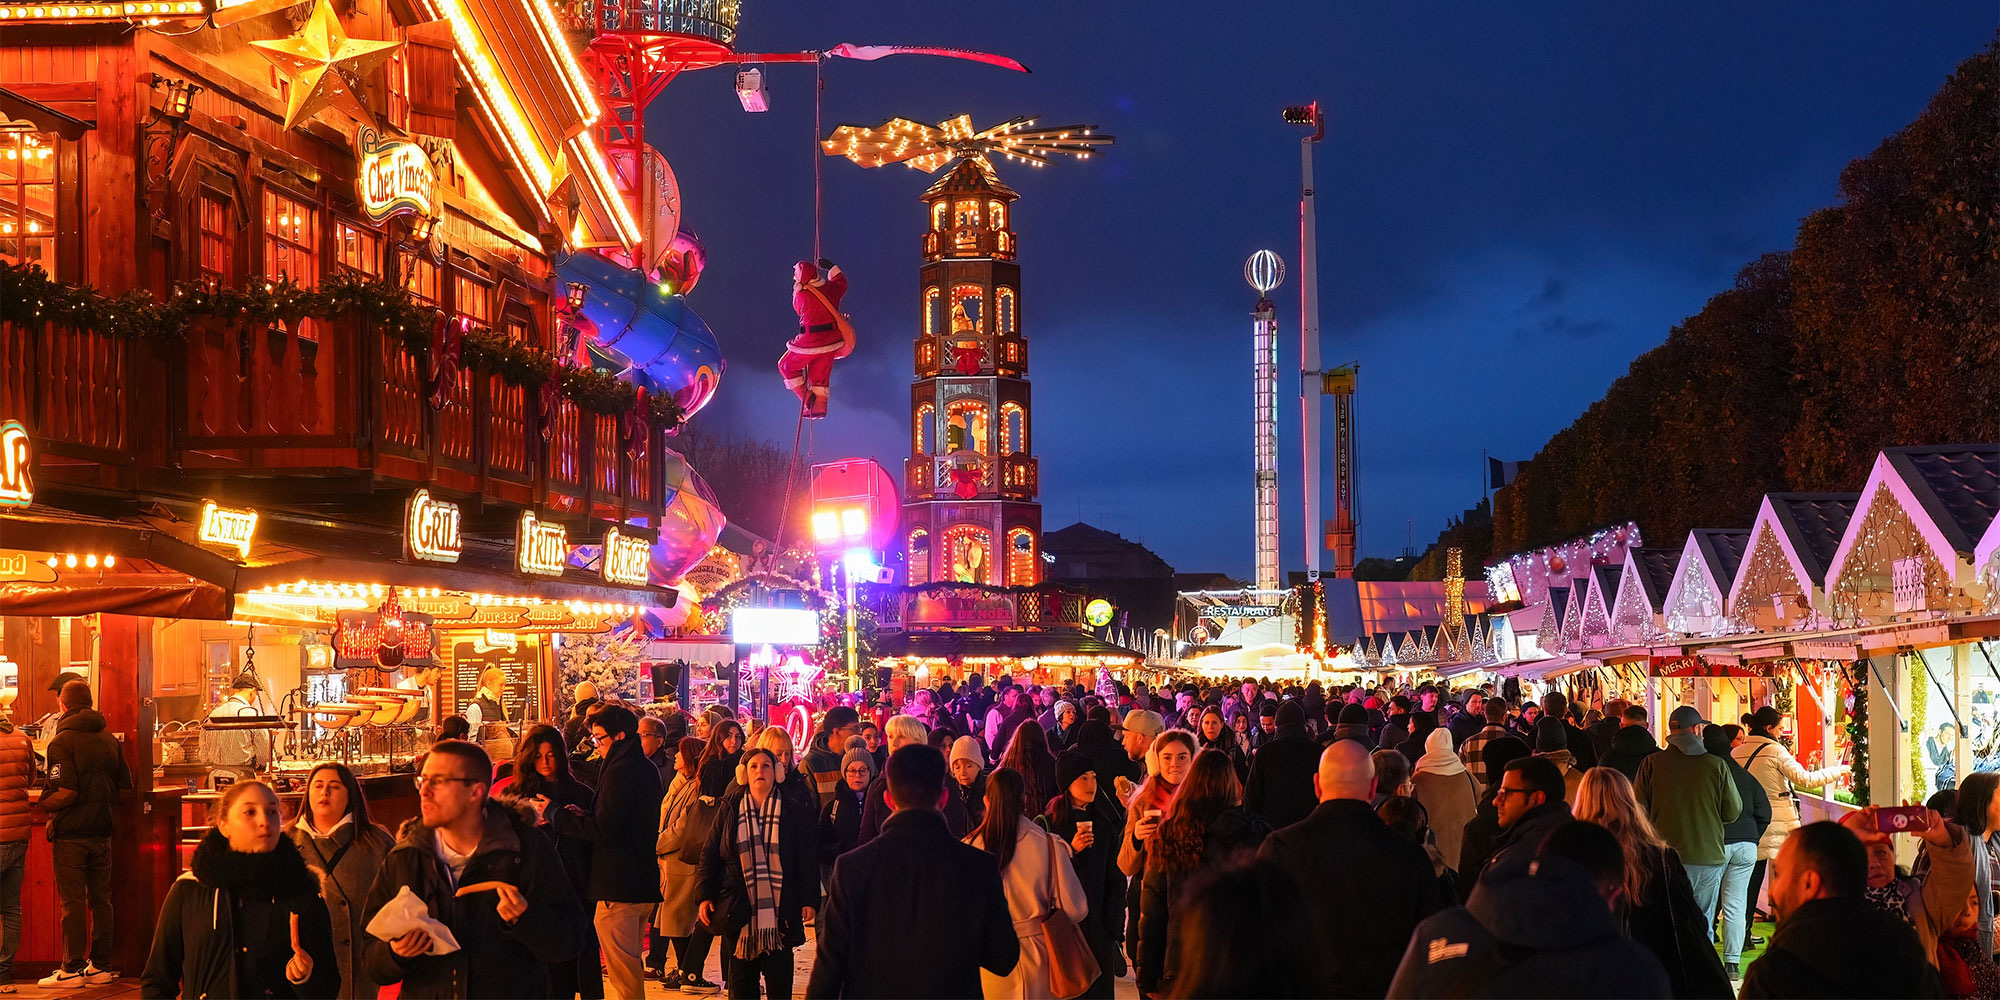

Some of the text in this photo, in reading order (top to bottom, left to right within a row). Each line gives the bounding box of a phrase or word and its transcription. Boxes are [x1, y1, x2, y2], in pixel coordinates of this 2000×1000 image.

[368, 160, 395, 203] Chez
[418, 500, 462, 552] GRILL
[527, 520, 568, 567] FRITES
[956, 609, 975, 620] DE
[976, 606, 1012, 620] NOËL
[1207, 606, 1276, 616] RESTAURANT
[1659, 658, 1694, 677] MERRY
